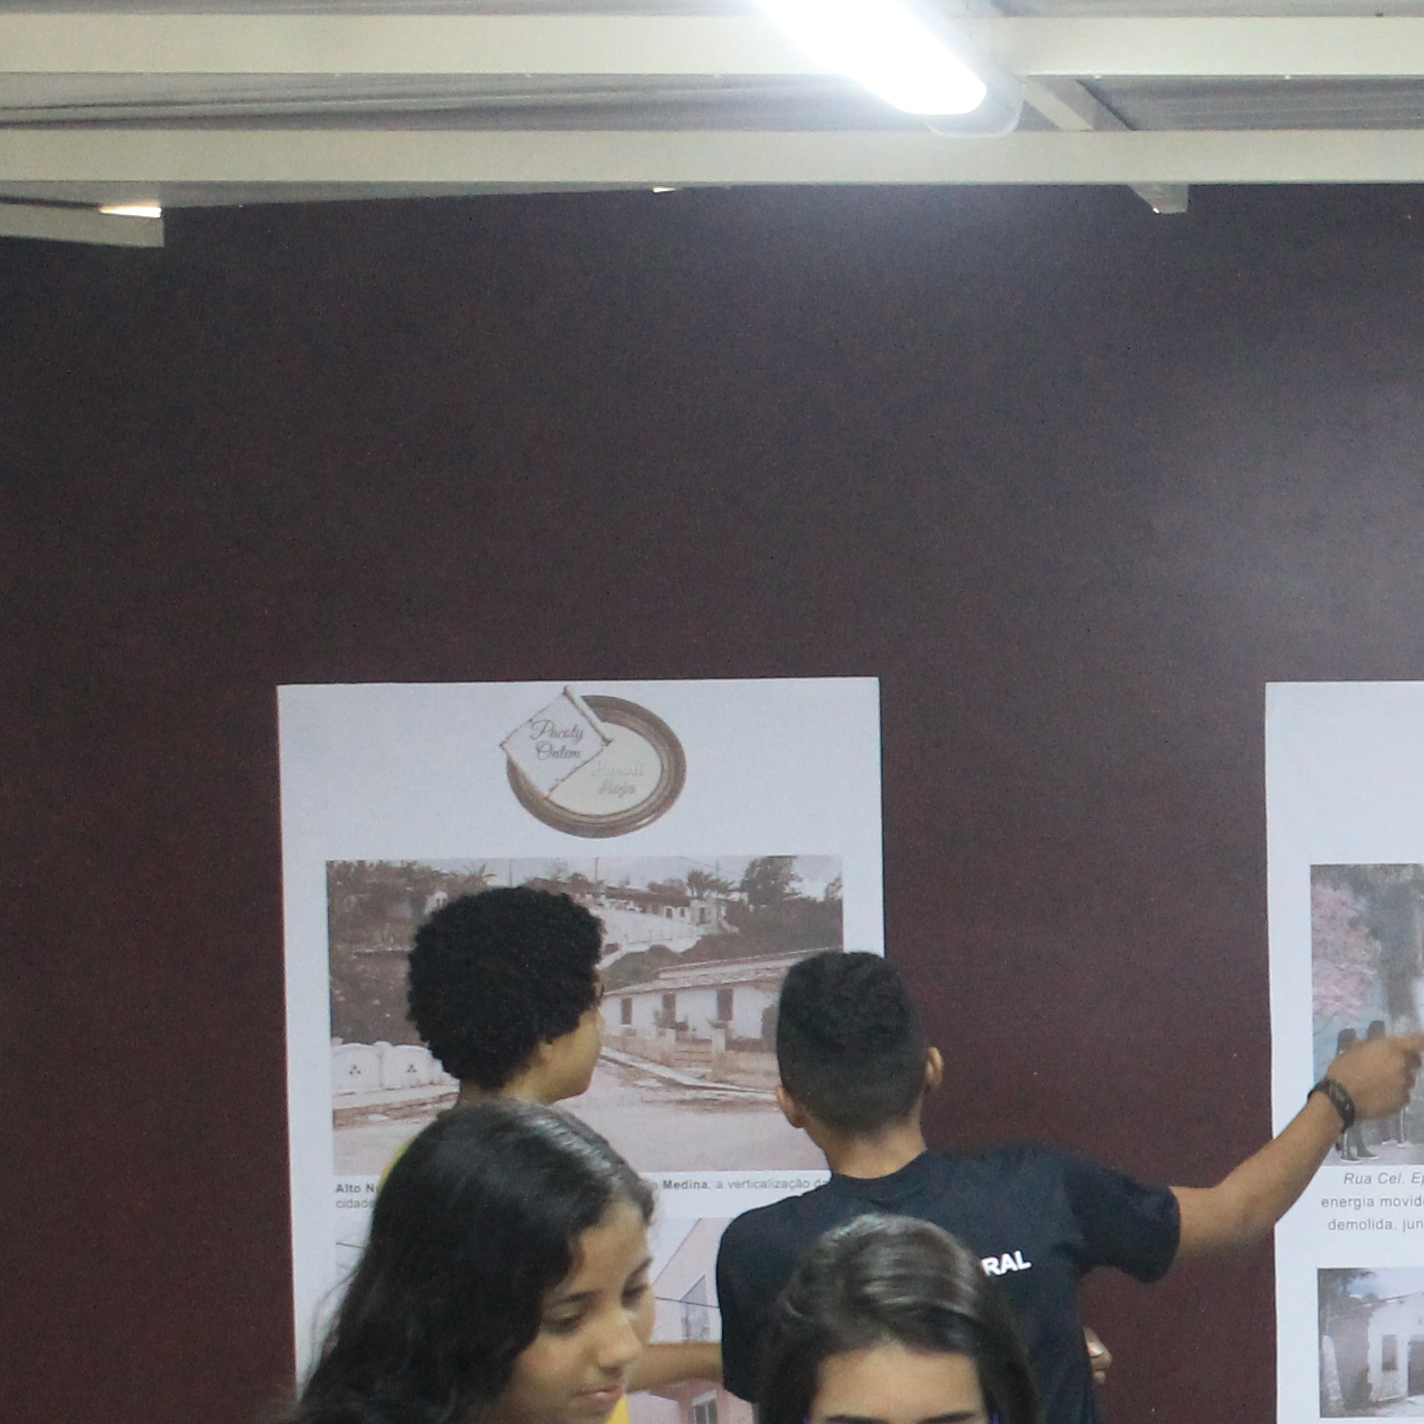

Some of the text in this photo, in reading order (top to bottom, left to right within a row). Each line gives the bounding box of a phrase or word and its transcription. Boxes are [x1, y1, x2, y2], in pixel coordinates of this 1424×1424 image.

[535, 740, 581, 761] Ontem
[727, 1178, 810, 1191] verticalização
[1343, 1172, 1372, 1185] Rua
[1378, 1172, 1405, 1185] Cel.
[336, 1183, 361, 1193] Alto
[1321, 1196, 1375, 1211] energia
[1328, 1217, 1397, 1231] demolida,
[980, 1250, 1033, 1277] RAL
